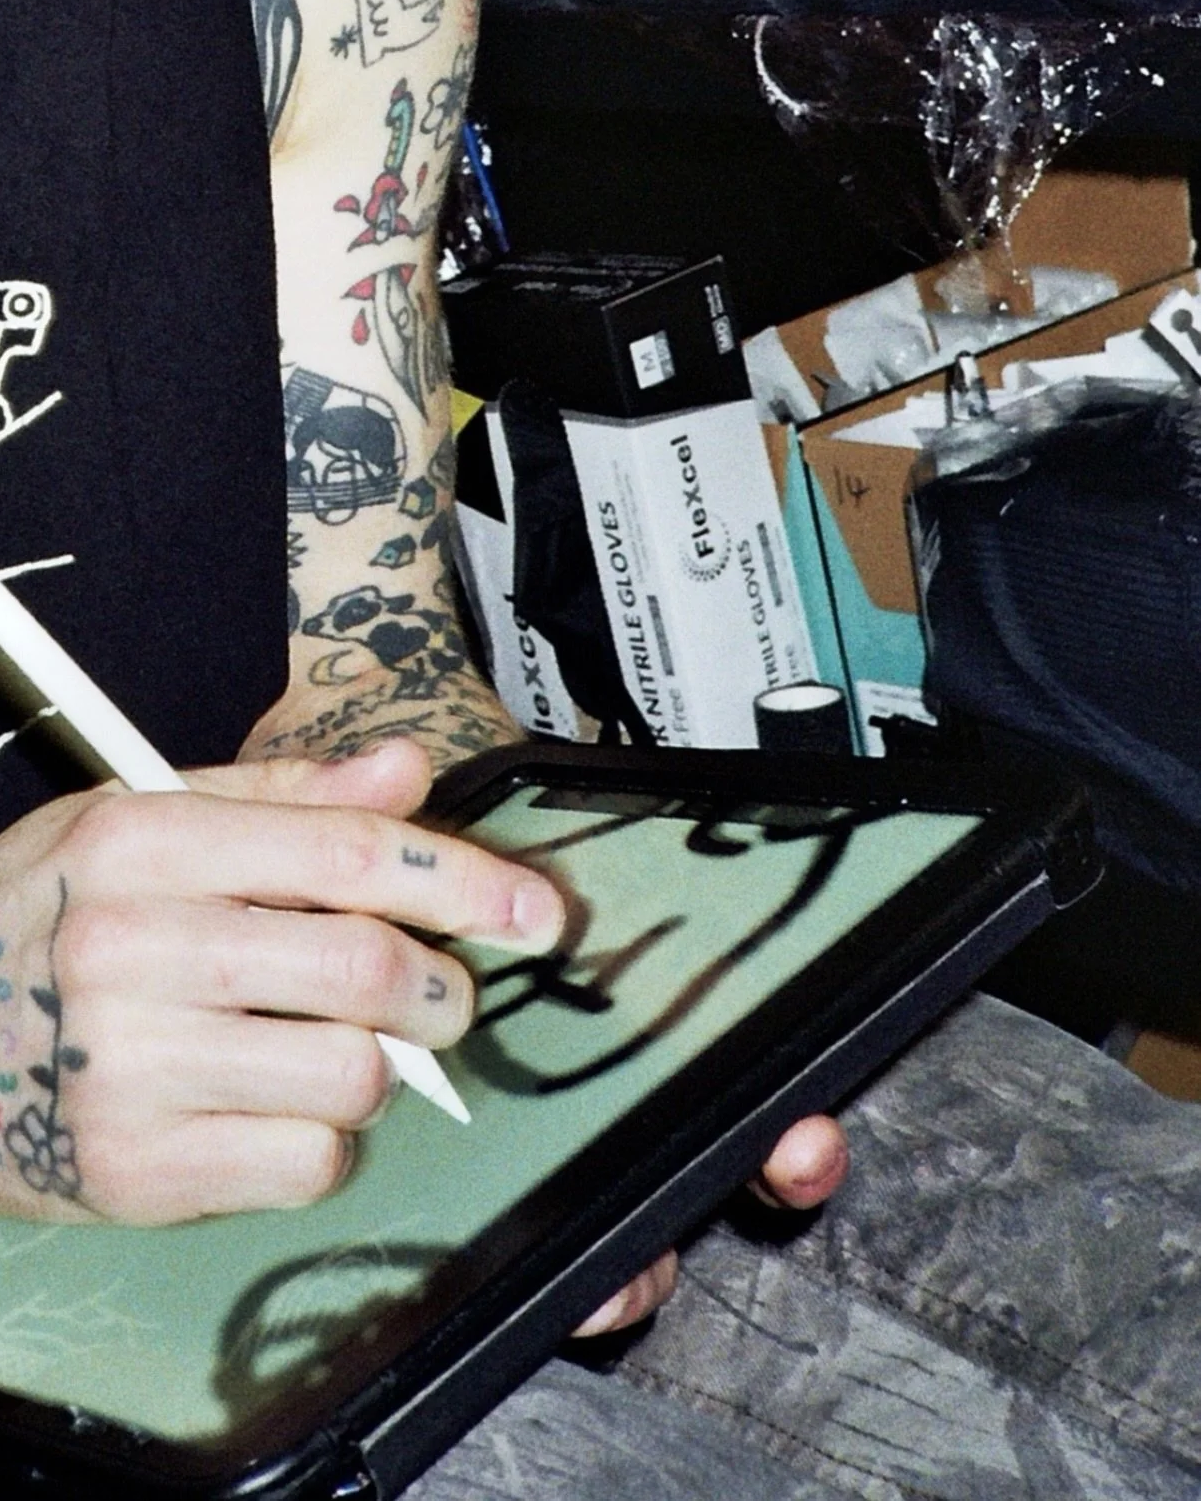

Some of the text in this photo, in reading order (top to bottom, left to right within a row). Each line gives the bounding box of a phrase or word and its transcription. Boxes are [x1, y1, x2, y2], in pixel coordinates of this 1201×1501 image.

[598, 500, 637, 609] GLOVES
[736, 538, 767, 627] GLOVES
[625, 614, 661, 718] NITRILE
[757, 628, 782, 687] TRILE
